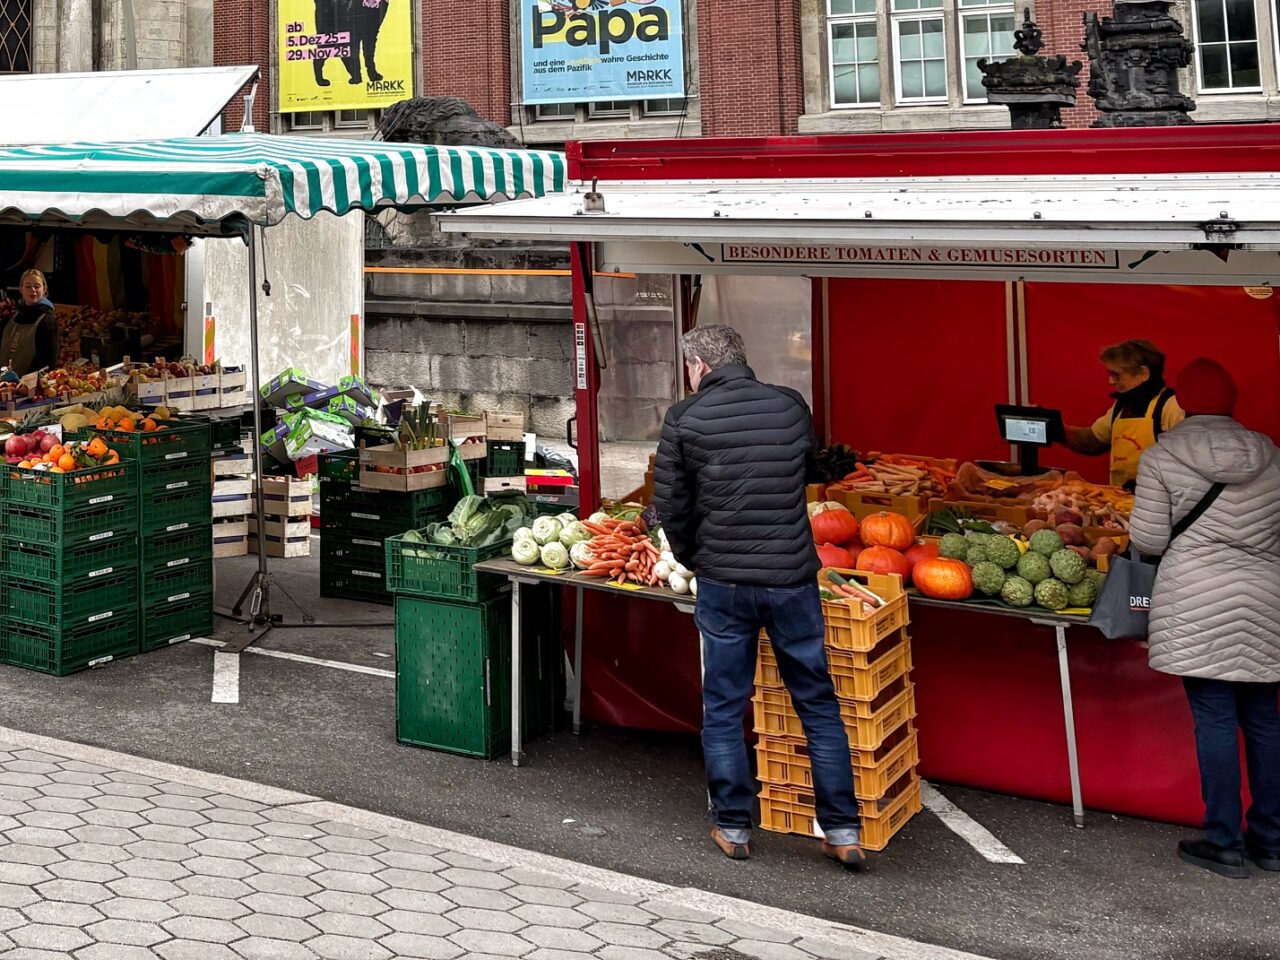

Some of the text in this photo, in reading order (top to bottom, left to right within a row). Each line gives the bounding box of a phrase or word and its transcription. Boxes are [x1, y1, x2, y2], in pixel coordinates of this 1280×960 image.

[287, 21, 302, 33] ab
[532, 6, 669, 54] Papa
[288, 46, 349, 60] 29. Nov 26
[600, 56, 624, 64] wahre
[626, 53, 670, 62] Geschichte
[567, 64, 592, 72] Pazifik
[626, 69, 672, 82] MARKK
[366, 80, 404, 91] MARKK
[729, 246, 831, 259] BESONDERE
[835, 248, 923, 261] TOMATEN
[928, 248, 941, 261] &
